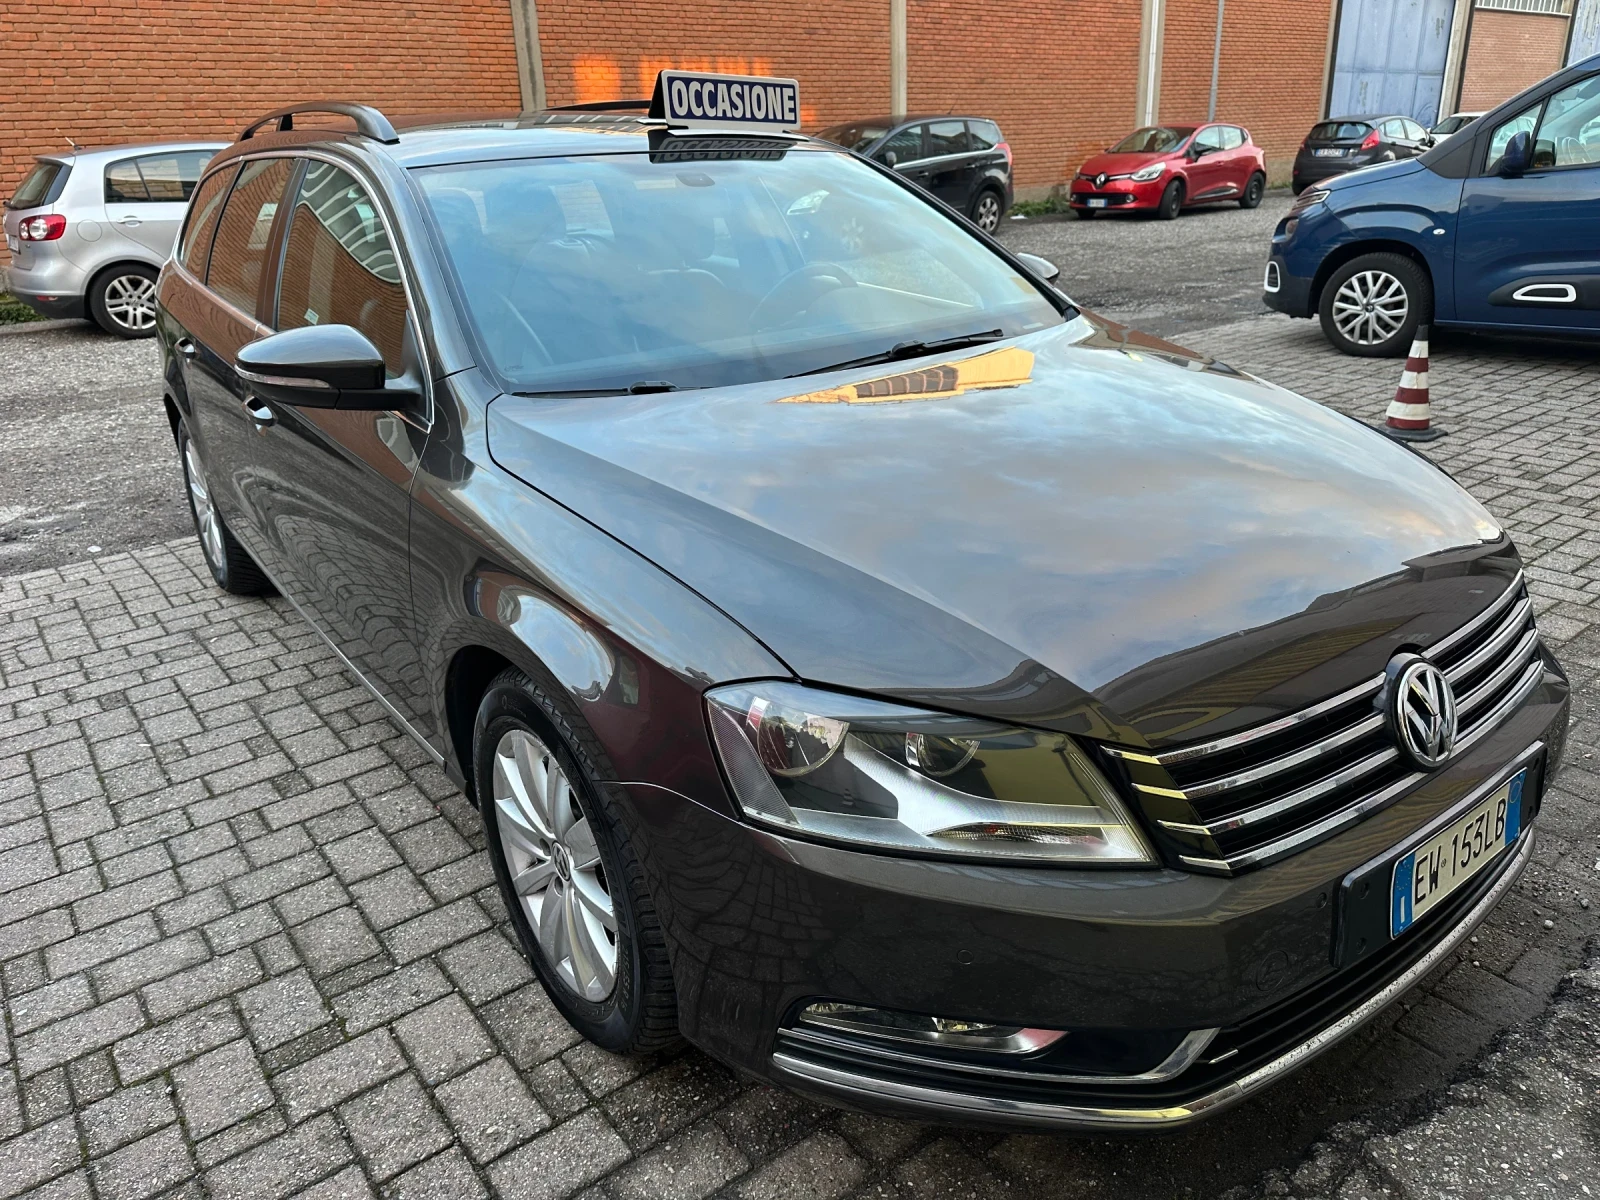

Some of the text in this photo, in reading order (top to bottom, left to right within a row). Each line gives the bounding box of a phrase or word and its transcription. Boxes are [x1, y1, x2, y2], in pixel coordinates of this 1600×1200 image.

[672, 80, 795, 120] OCCASIONE
[1415, 845, 1442, 905] EW
[1451, 797, 1507, 877] 153LB
